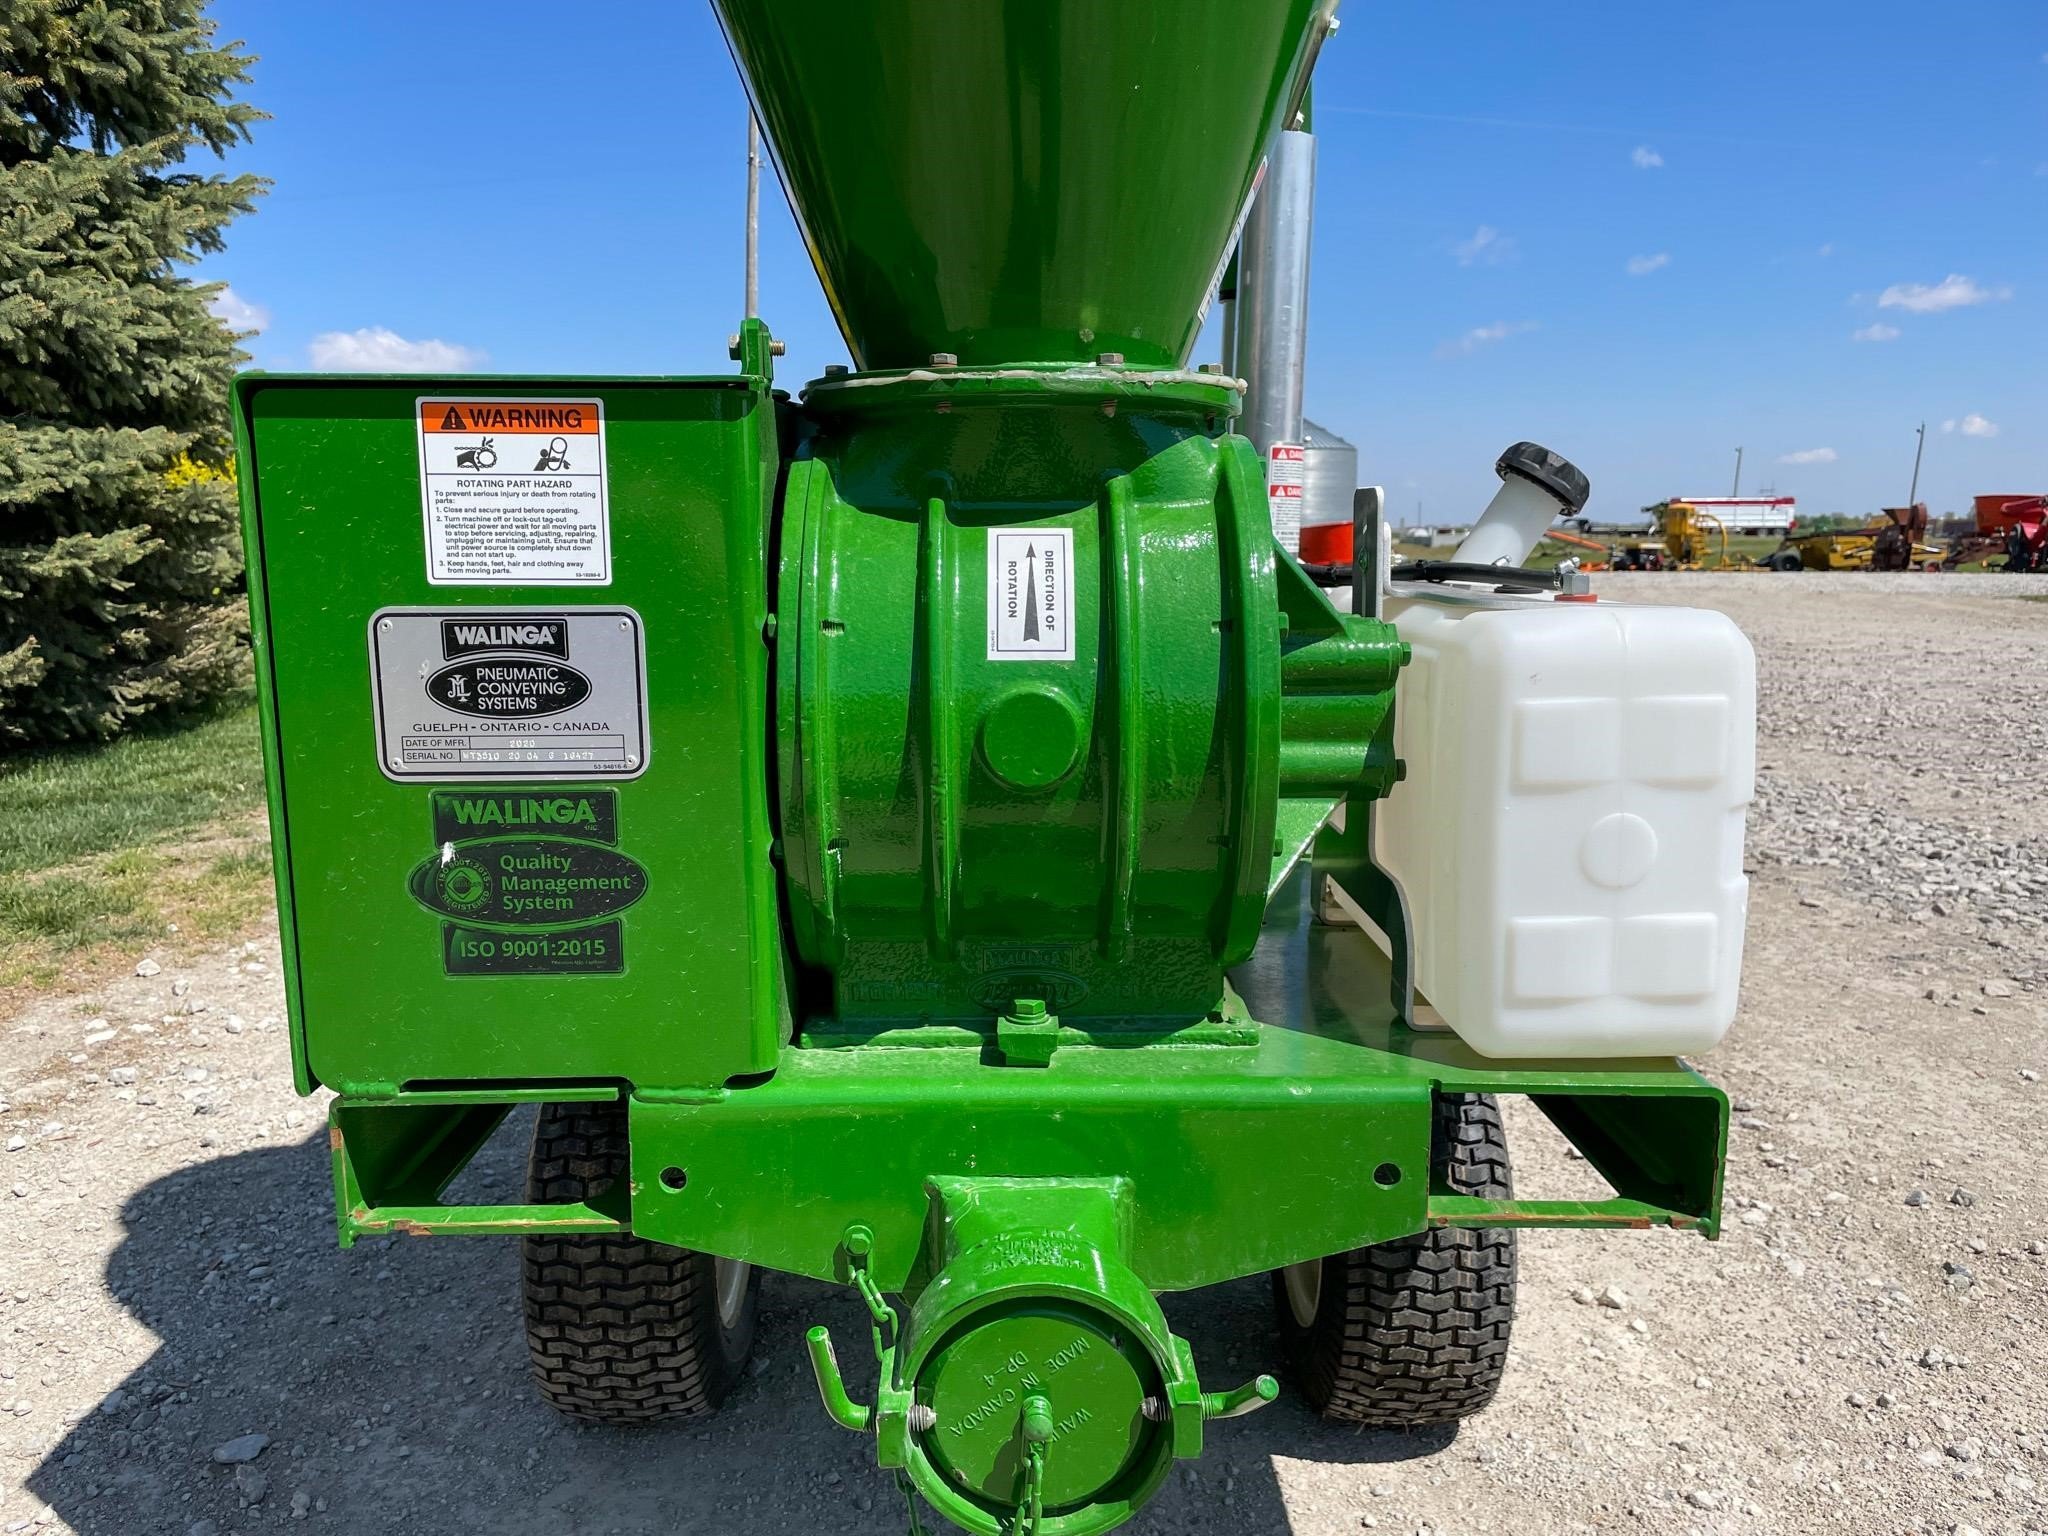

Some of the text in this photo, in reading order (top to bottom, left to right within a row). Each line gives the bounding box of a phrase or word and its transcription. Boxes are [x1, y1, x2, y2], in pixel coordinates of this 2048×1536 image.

[469, 408, 582, 428] WARNING
[457, 480, 572, 488] ROTATING PART HAZARD
[569, 491, 595, 499] rotating
[502, 507, 522, 515] guard
[546, 507, 580, 515] operating.
[1008, 561, 1017, 618] ROTATION
[1045, 550, 1055, 631] DIRECTION OF
[454, 625, 555, 645] WALINGA
[476, 667, 559, 681] PNEUMATIC
[477, 682, 566, 695] CONVEYING
[478, 697, 537, 710] SYSTEMS
[413, 723, 468, 732] GUELPH
[481, 723, 541, 732] ONTARIO
[553, 722, 610, 731] CANADA
[405, 739, 466, 747] DATE OF MFR.
[509, 739, 535, 748] 2020
[406, 751, 455, 760] SERIAL NO.
[452, 799, 597, 824] WALINGA
[500, 855, 572, 873] Quality
[501, 876, 631, 894] Management
[503, 896, 573, 913] System
[461, 940, 606, 957] ISO 9001:2015
[950, 1336, 1091, 1438] MADE IN CANADA
